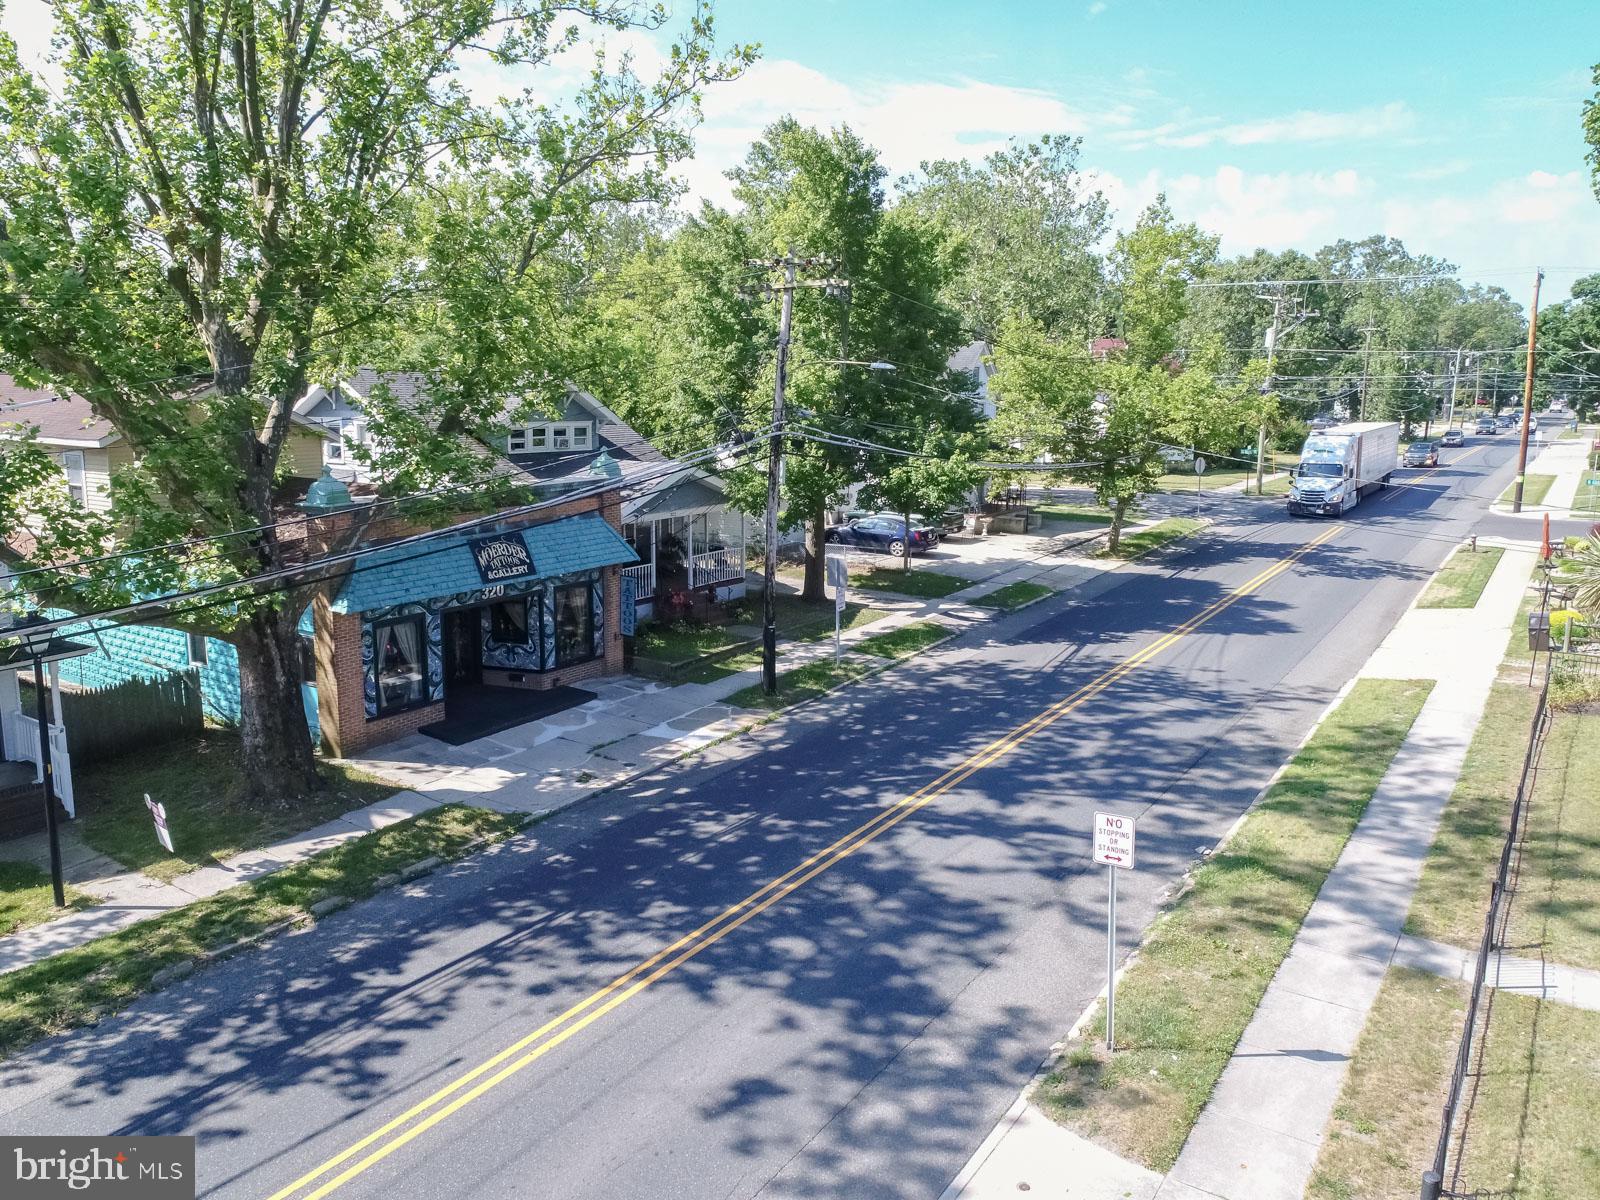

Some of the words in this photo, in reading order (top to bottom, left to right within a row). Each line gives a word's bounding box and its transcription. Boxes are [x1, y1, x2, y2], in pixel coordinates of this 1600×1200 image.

[490, 555, 521, 570] TATTOOS
[481, 584, 505, 600] 320
[622, 578, 634, 634] TATTOOS
[1106, 817, 1123, 829] NO
[1098, 828, 1130, 840] STOPPING
[1109, 837, 1119, 845] OR
[1098, 843, 1130, 856] STANDING
